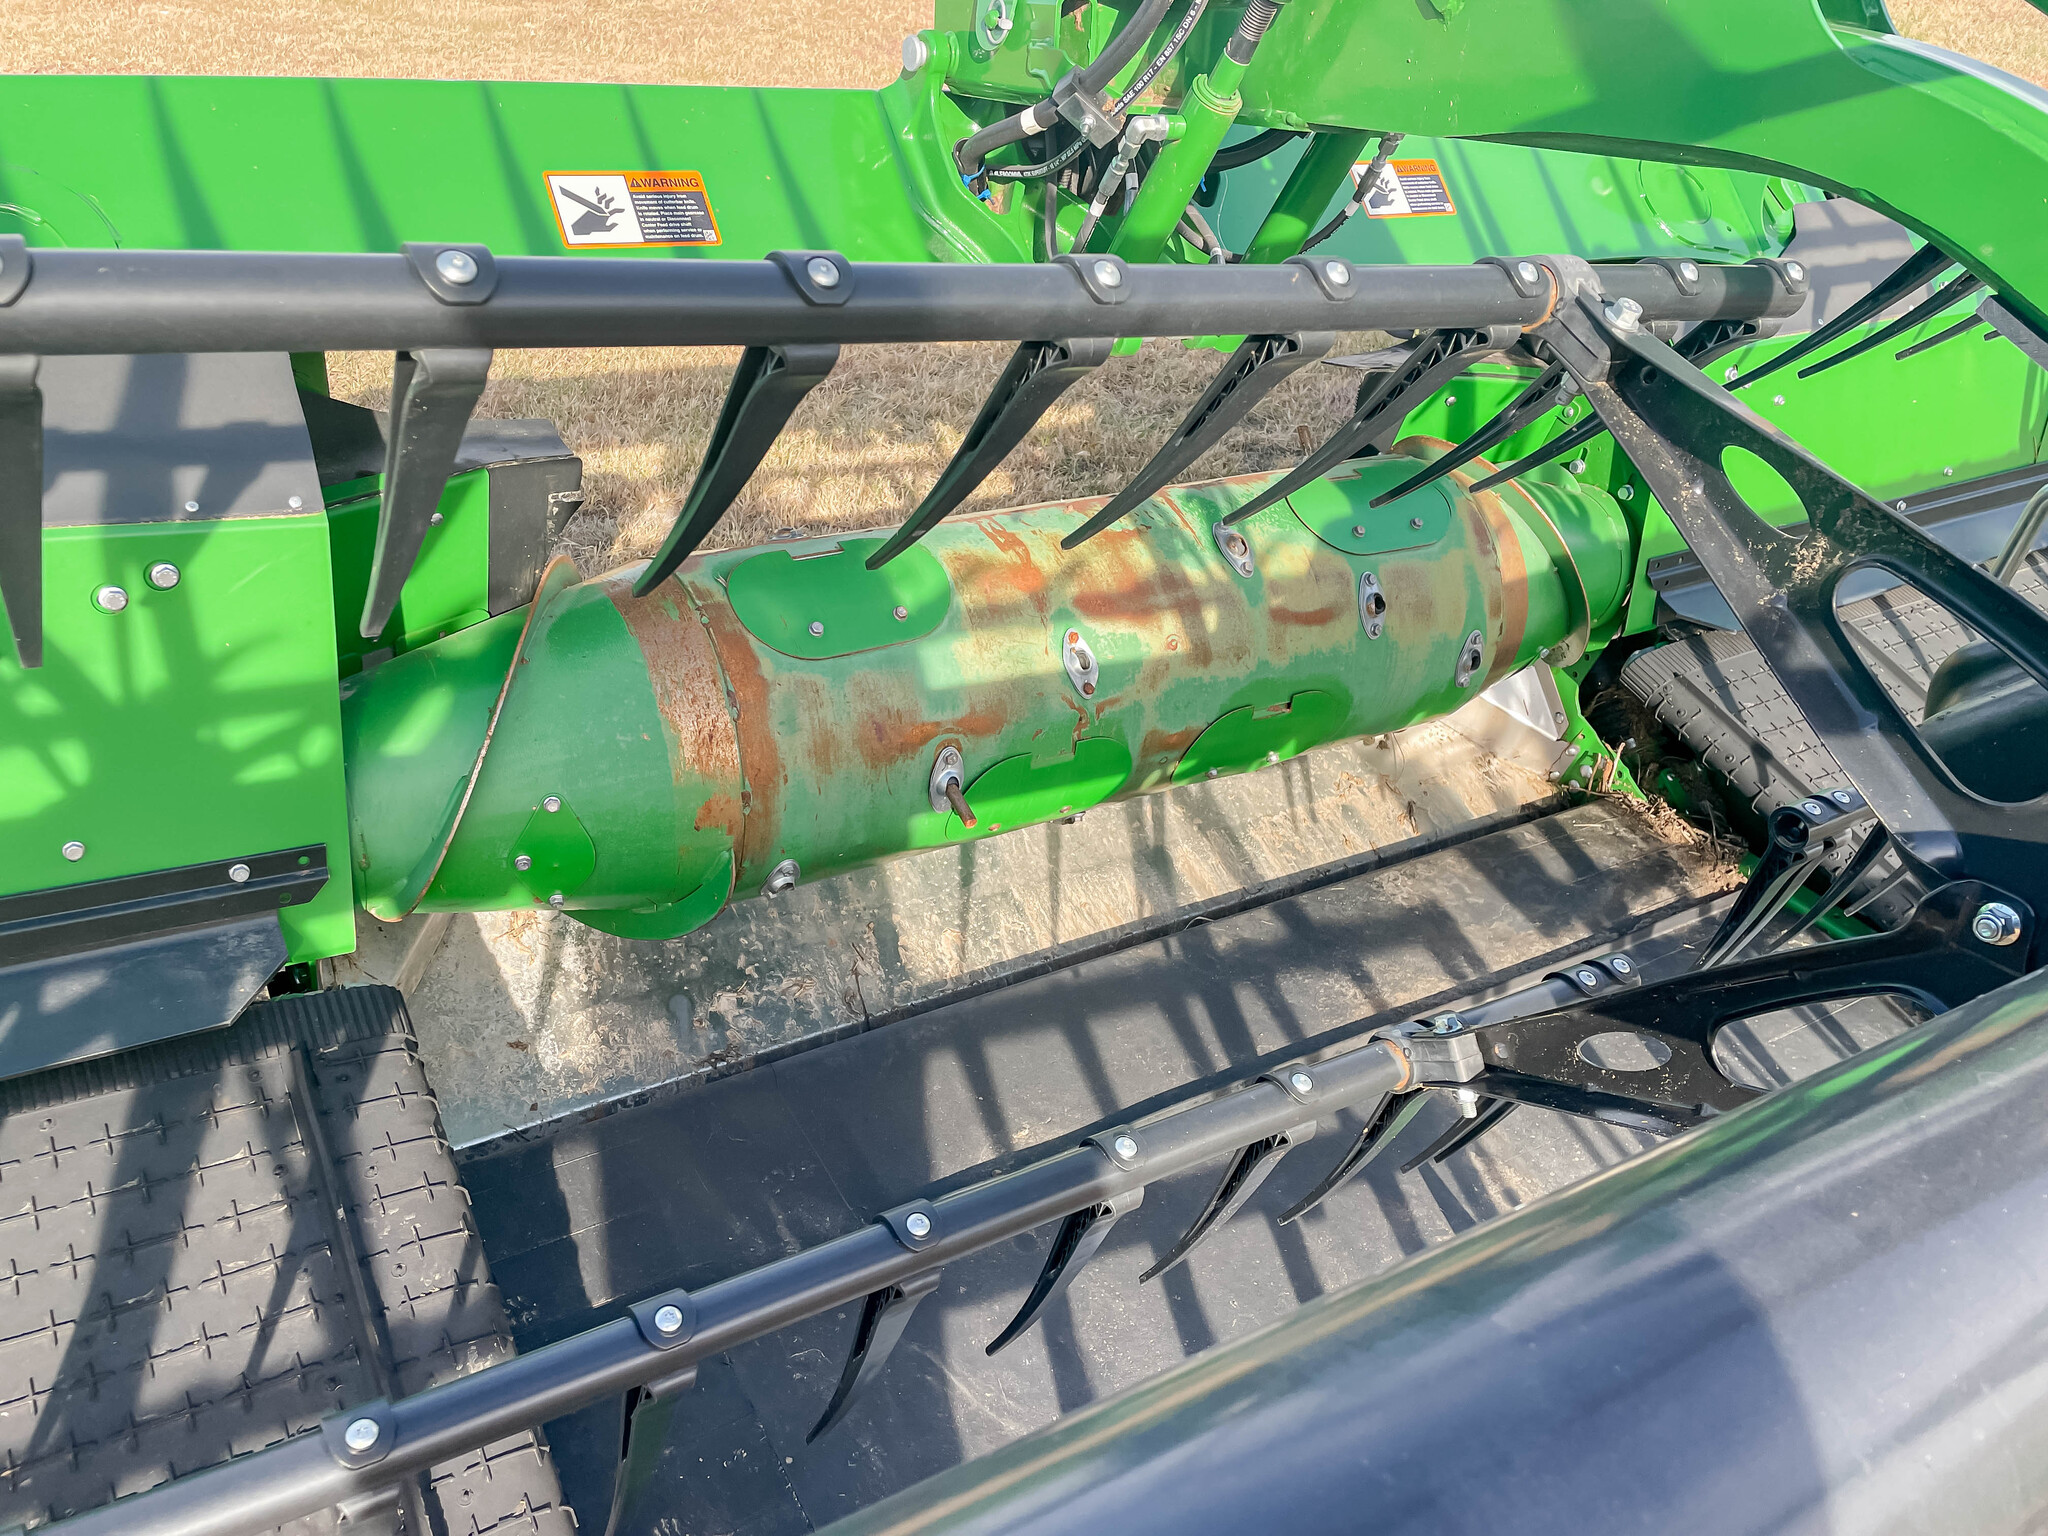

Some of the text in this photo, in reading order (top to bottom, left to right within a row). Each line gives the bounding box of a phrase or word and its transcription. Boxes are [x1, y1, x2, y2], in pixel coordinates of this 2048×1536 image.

[1123, 90, 1135, 103] SAE
[1134, 81, 1144, 91] 100
[1143, 69, 1154, 82] R17
[1156, 55, 1166, 66] EN
[1164, 43, 1175, 56] 857
[1174, 29, 1185, 43] 1SC
[1182, 17, 1192, 29] DN
[640, 178, 699, 187] WARNING
